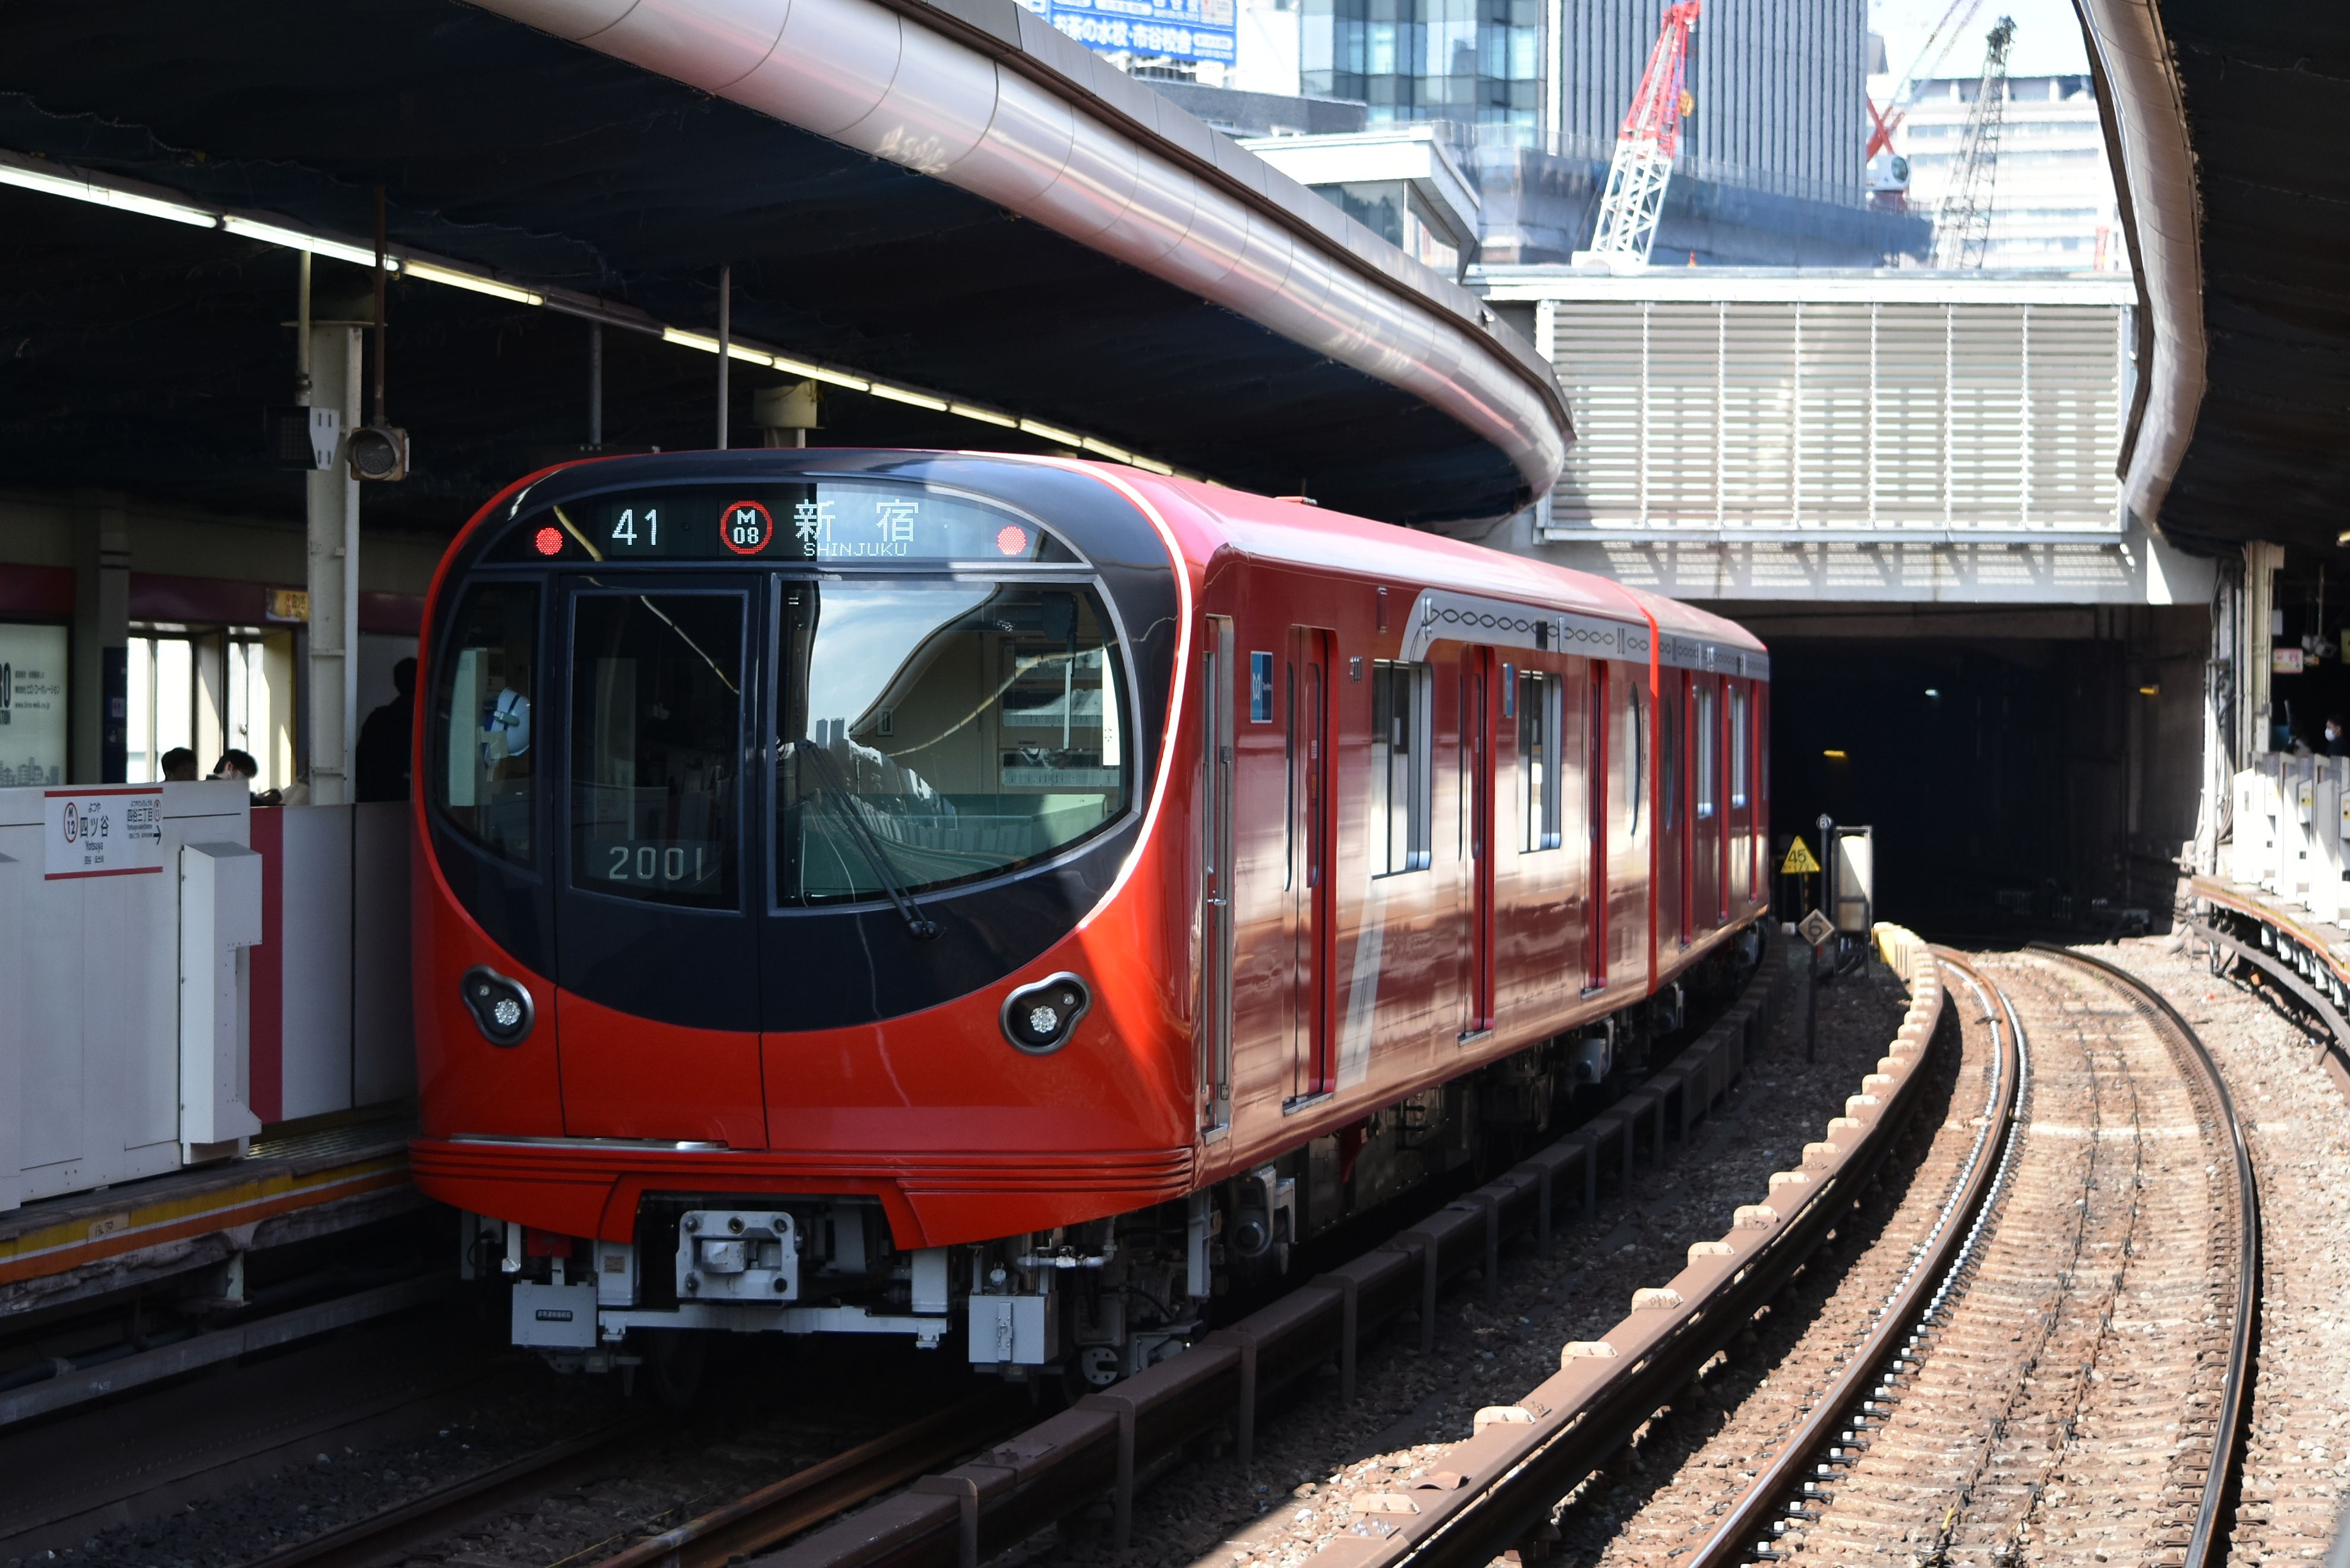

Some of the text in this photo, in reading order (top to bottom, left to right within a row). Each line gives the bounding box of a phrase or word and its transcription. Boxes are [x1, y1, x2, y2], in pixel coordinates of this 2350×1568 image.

[736, 509, 755, 525] M
[794, 499, 919, 542] 新宿
[612, 508, 658, 545] 41
[733, 526, 759, 544] 08
[803, 542, 907, 557] SHINJUKU
[68, 807, 74, 815] M
[89, 802, 102, 813] よつや
[127, 808, 153, 822] 四谷三丁目
[67, 821, 75, 835] 12
[80, 815, 109, 838] 四ツ谷
[86, 840, 103, 853] Yotsuya
[609, 846, 702, 881] 2001
[1788, 849, 1807, 863] 45
[1809, 916, 1822, 937] 6
